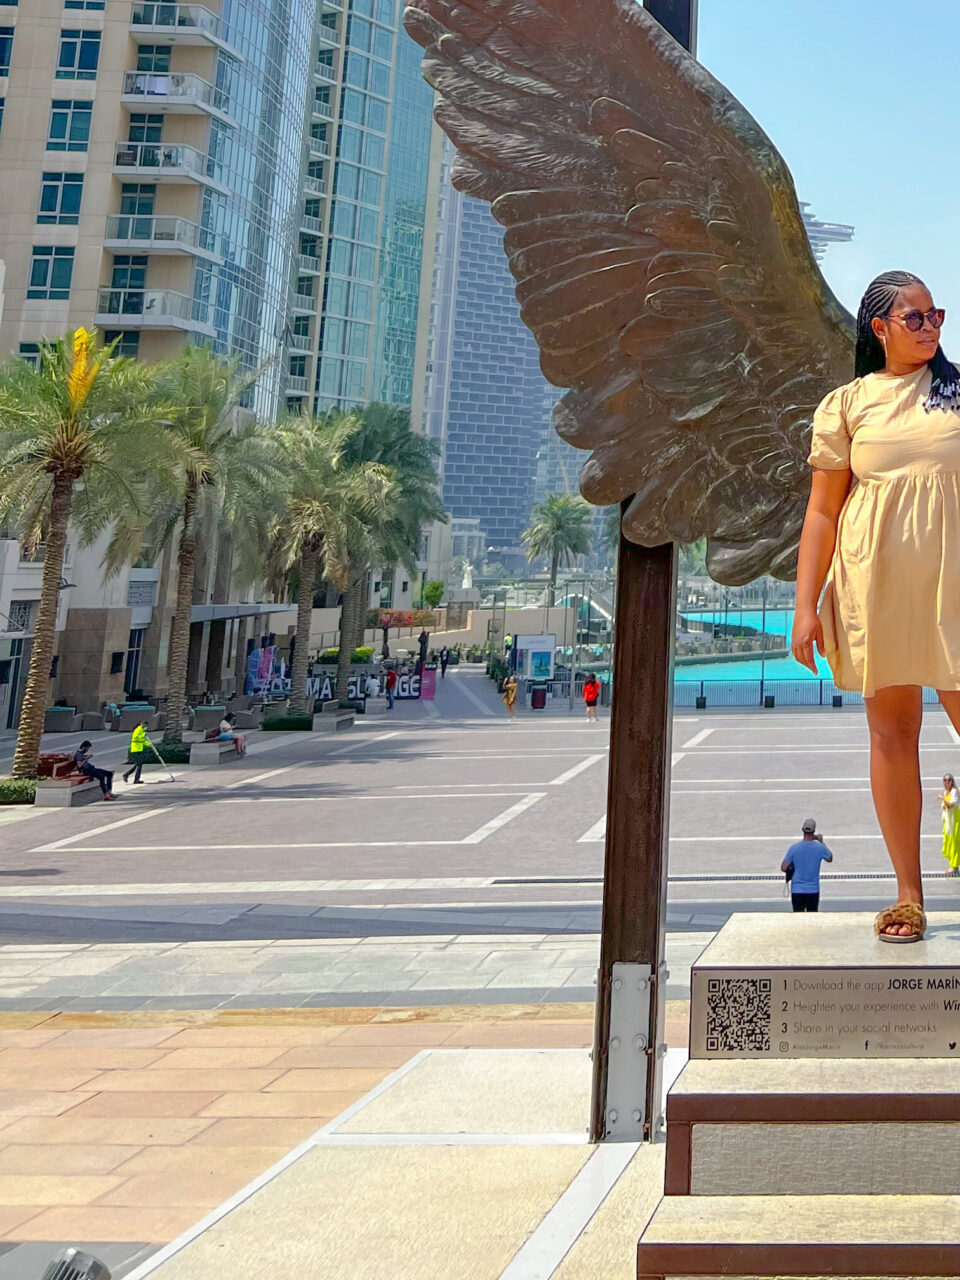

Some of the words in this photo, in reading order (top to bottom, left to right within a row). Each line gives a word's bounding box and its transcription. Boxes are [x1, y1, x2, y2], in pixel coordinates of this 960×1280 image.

[783, 979, 788, 991] 1
[793, 979, 844, 991] Download
[846, 979, 861, 991] the
[864, 981, 885, 993] app
[887, 978, 923, 990] JORGE
[781, 1000, 789, 1012] 2
[793, 1000, 837, 1014] Heighten
[839, 1003, 860, 1014] your
[863, 1002, 916, 1014] experience
[919, 1000, 939, 1011] with
[781, 1022, 788, 1034] 3
[793, 1022, 822, 1034] Share
[825, 1022, 834, 1033] in
[837, 1024, 859, 1036] your
[861, 1021, 891, 1033] social
[894, 1021, 937, 1033] networks
